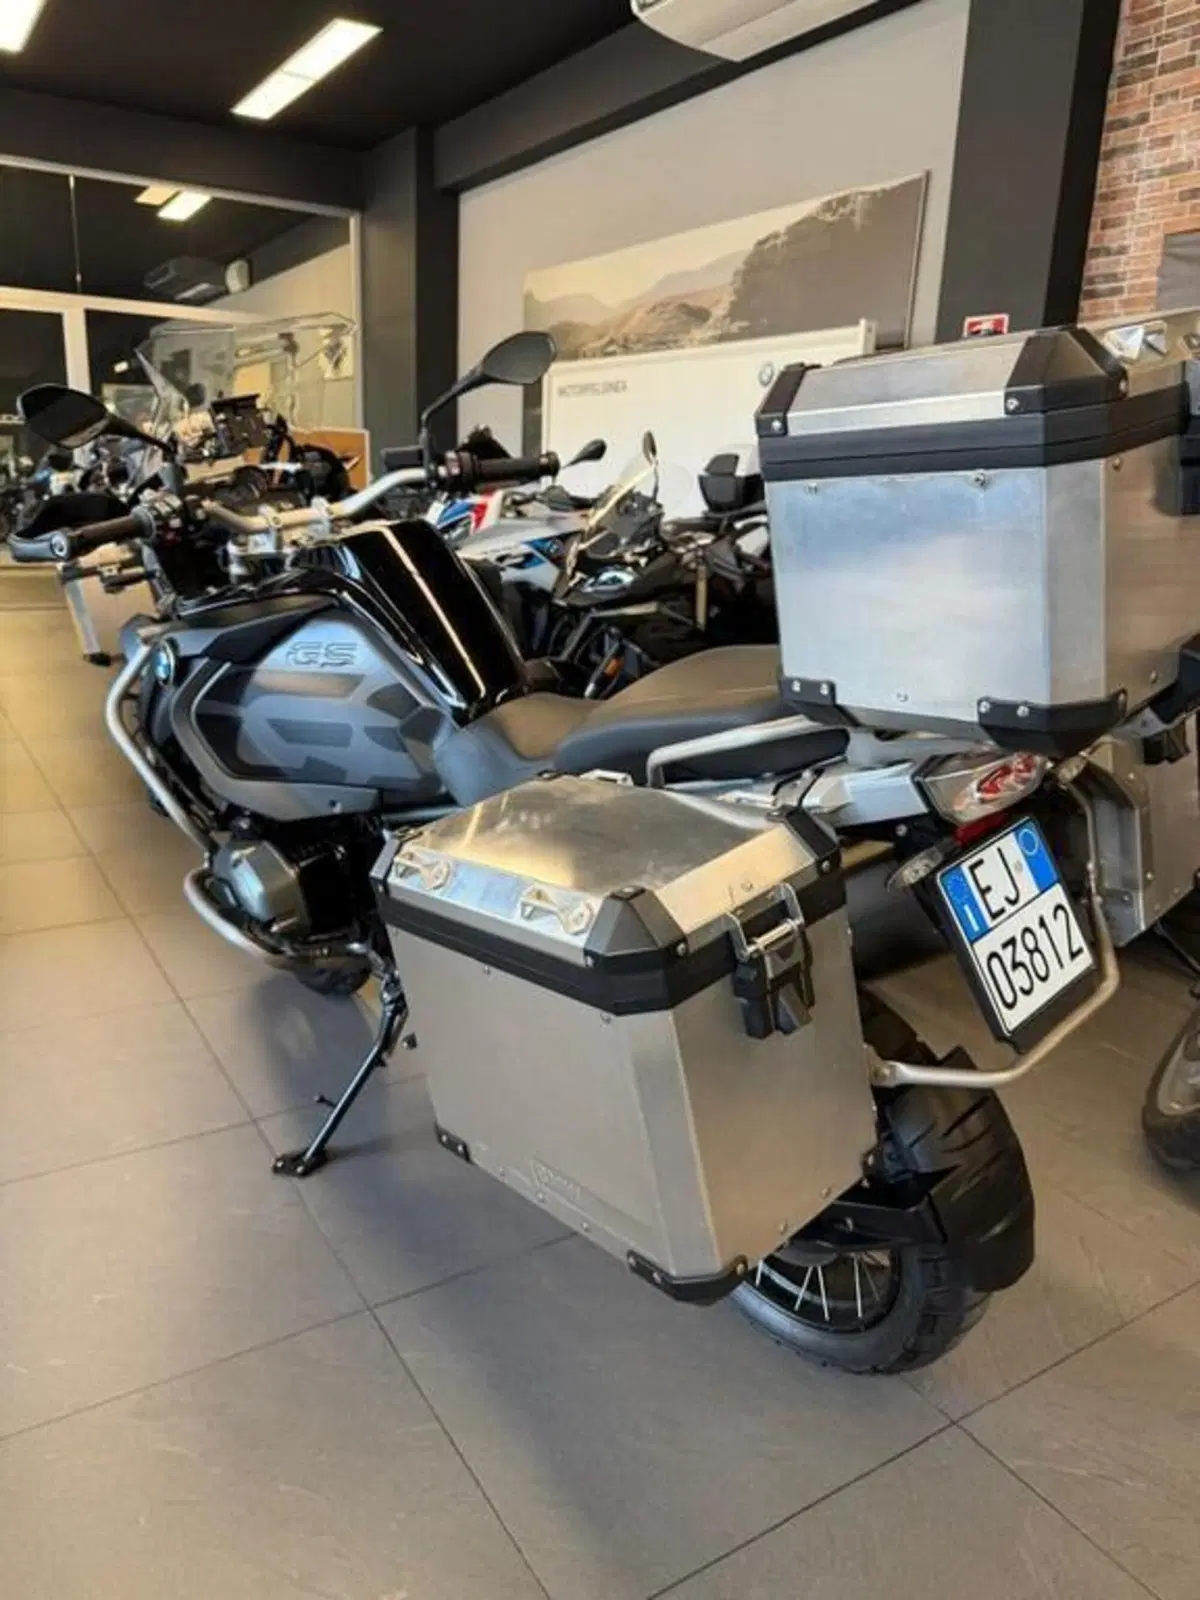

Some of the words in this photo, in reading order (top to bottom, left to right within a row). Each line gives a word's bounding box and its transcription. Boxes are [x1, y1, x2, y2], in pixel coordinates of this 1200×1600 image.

[285, 641, 358, 668] GS
[968, 848, 1020, 920] EJ
[986, 903, 1084, 1010] 03812
